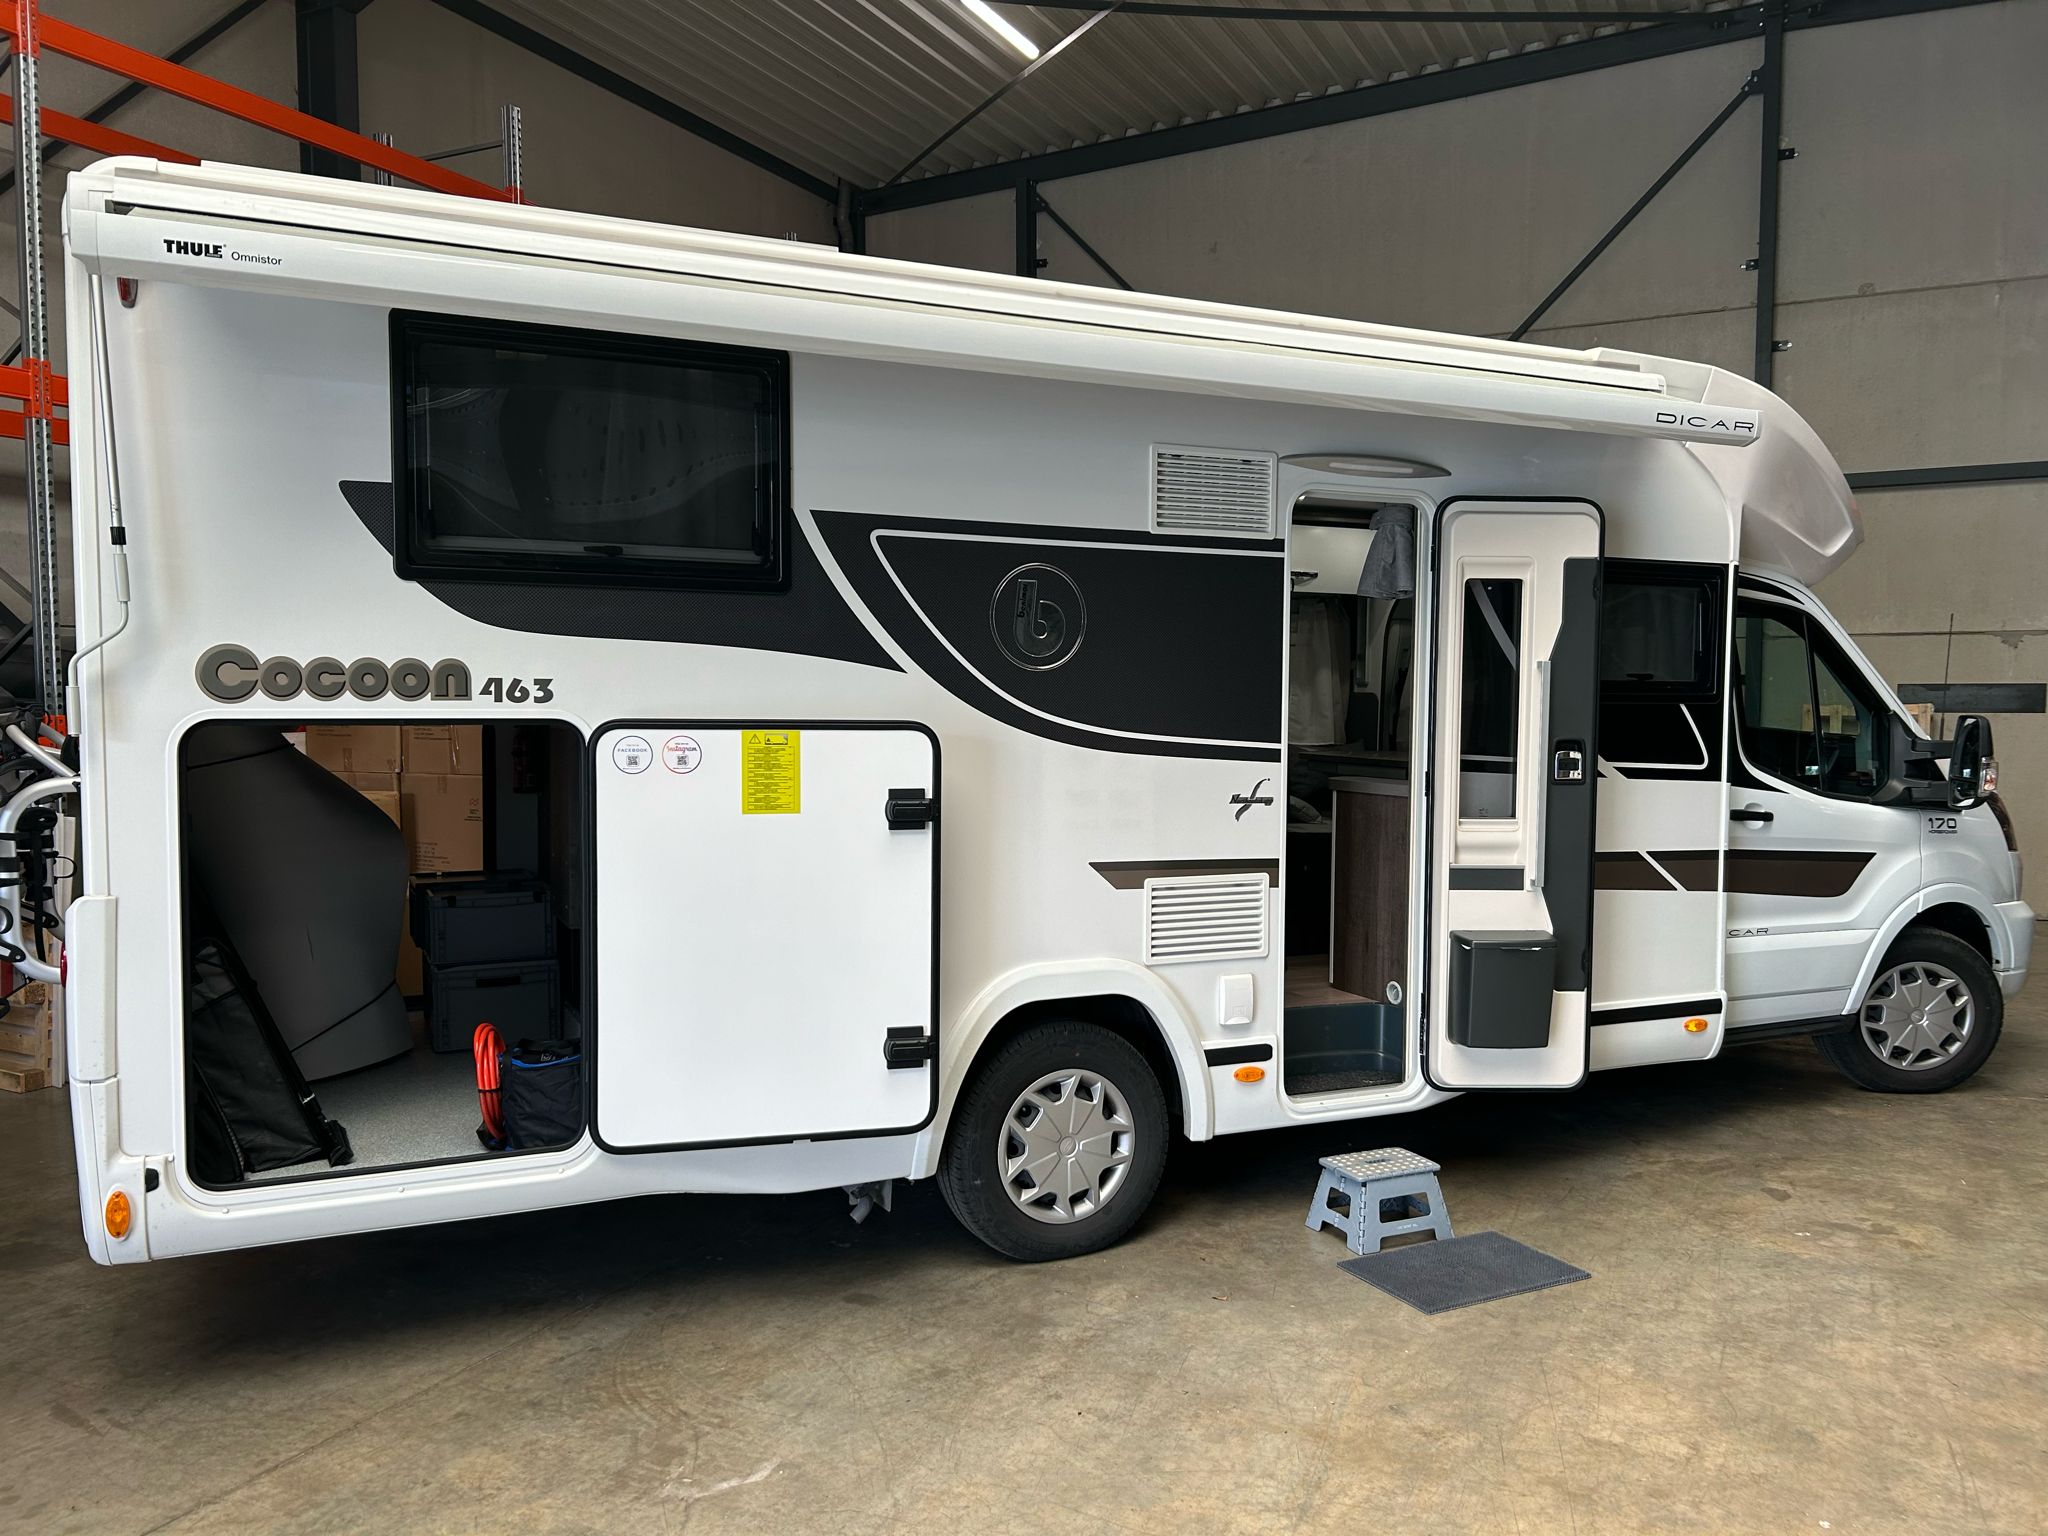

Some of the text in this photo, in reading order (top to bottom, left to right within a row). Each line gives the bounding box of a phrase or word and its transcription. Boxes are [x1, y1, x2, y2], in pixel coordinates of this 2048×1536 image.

[163, 239, 283, 265] THULE Omnistor
[1656, 412, 1755, 433] DICAR
[195, 643, 472, 704] Cocoon
[478, 676, 555, 704] 463
[1928, 817, 1957, 829] 170
